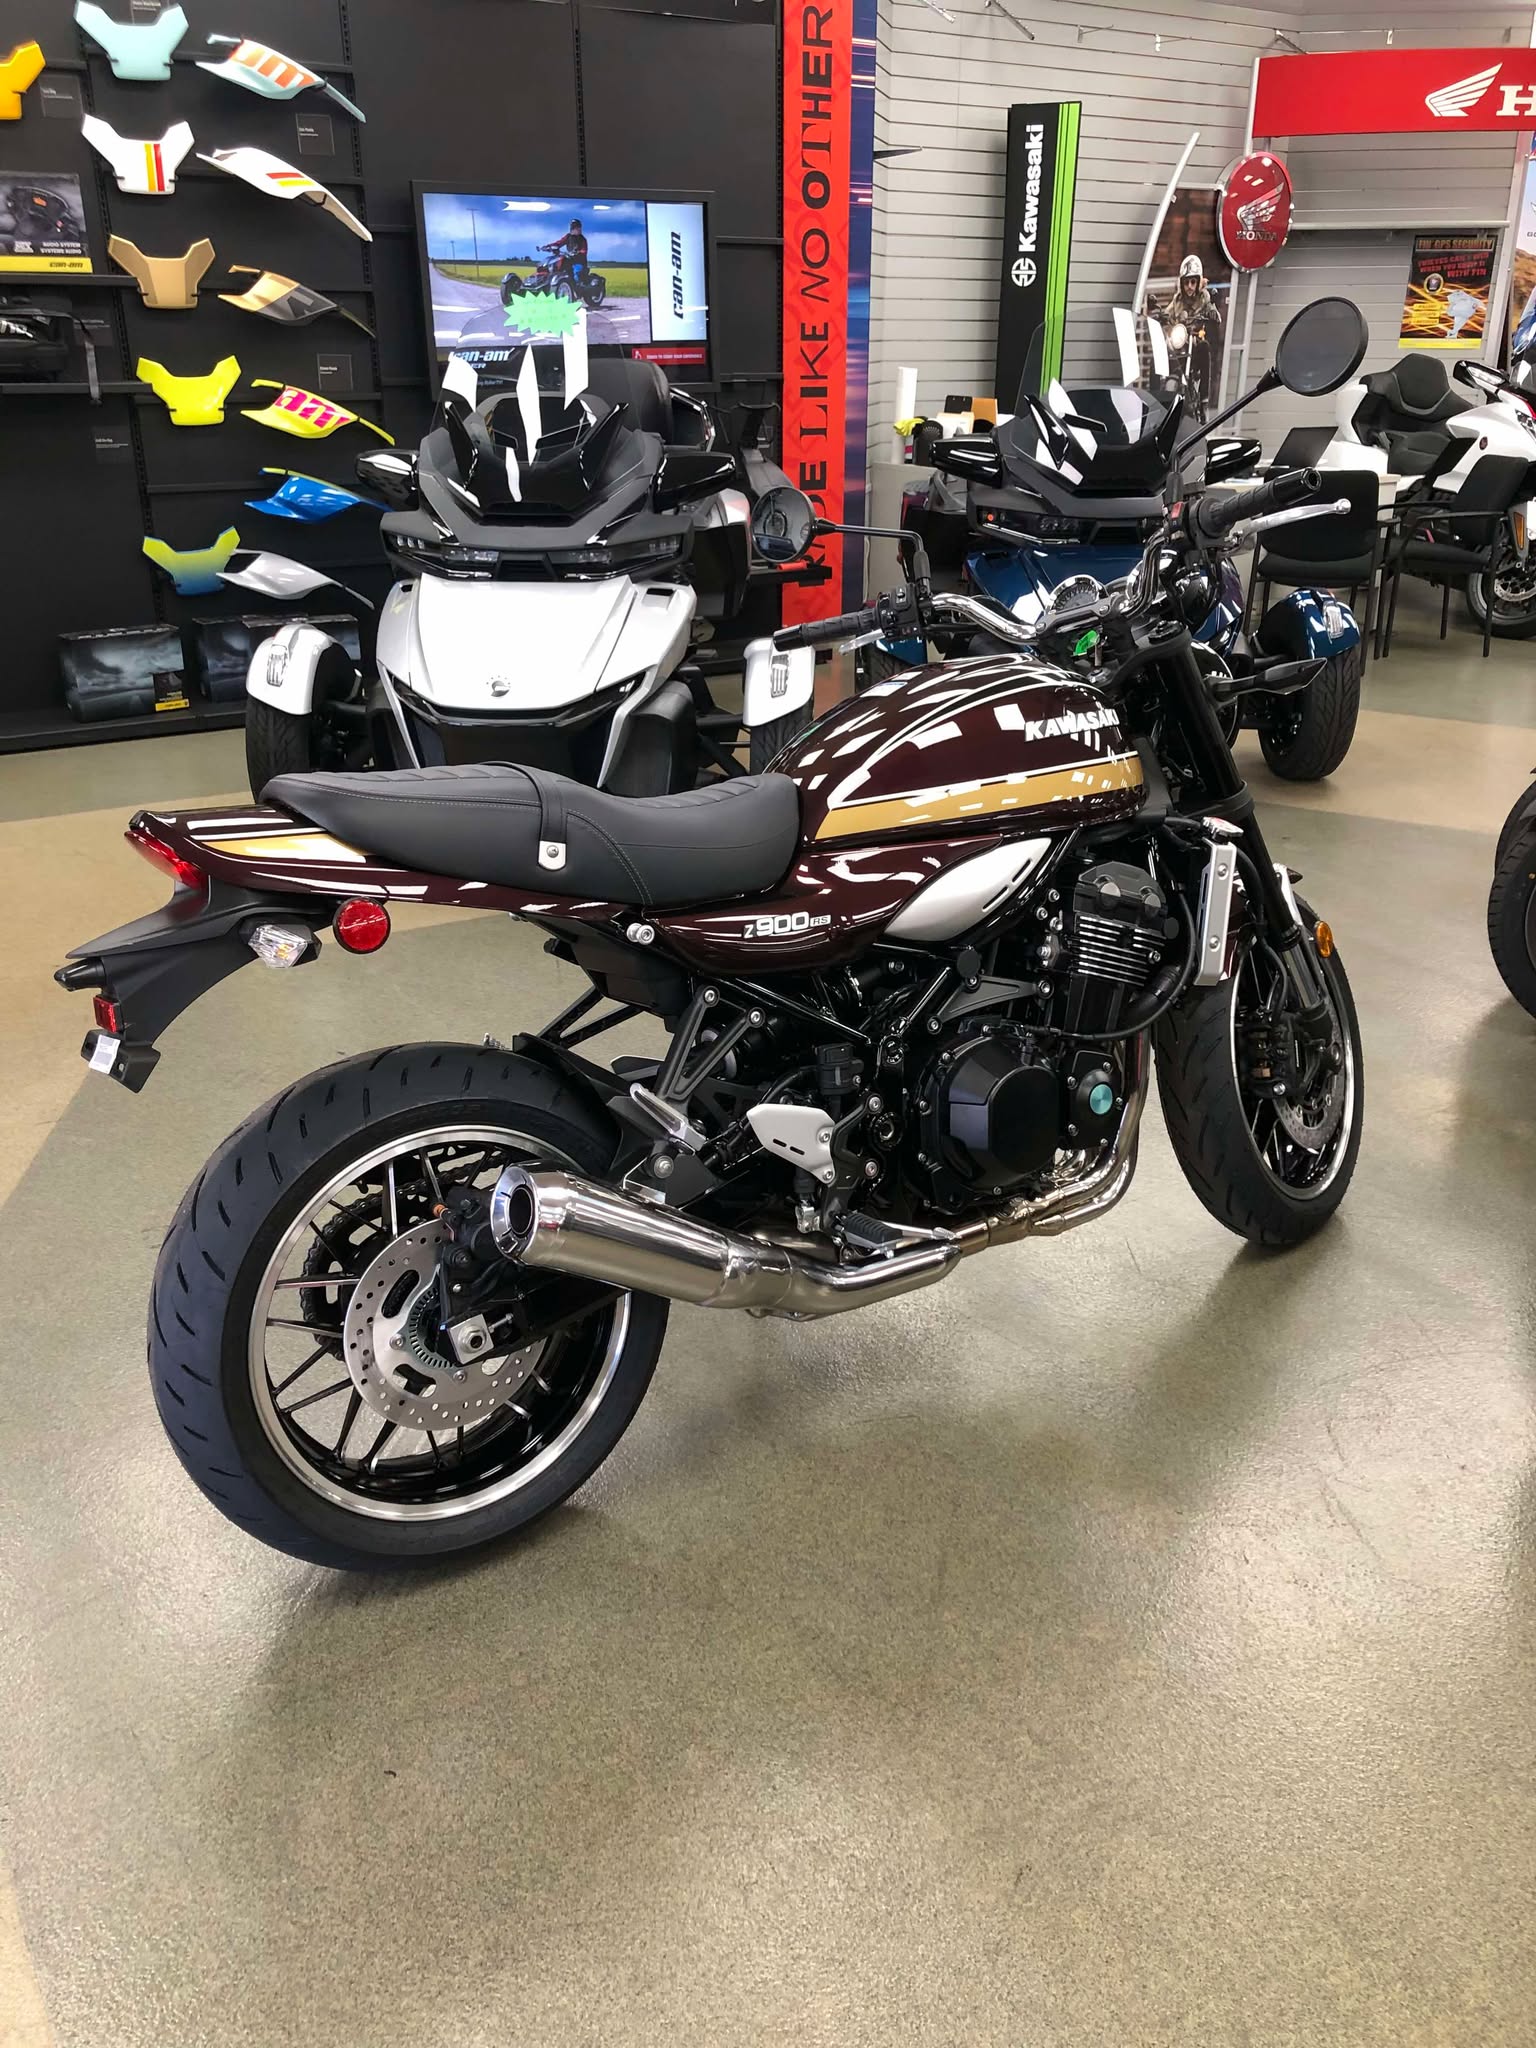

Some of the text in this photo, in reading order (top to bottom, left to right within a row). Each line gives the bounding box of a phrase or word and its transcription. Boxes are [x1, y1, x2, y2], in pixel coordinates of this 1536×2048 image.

[801, 5, 833, 210] OTHER
[1018, 124, 1045, 252] Kawasaki
[800, 228, 830, 303] NO
[1236, 230, 1278, 241] HONDA
[1452, 239, 1493, 249] SECURITY
[671, 231, 684, 319] can-am
[800, 322, 829, 440] LIKE
[1025, 708, 1120, 741] KAWASAKI
[811, 915, 831, 927] RS
